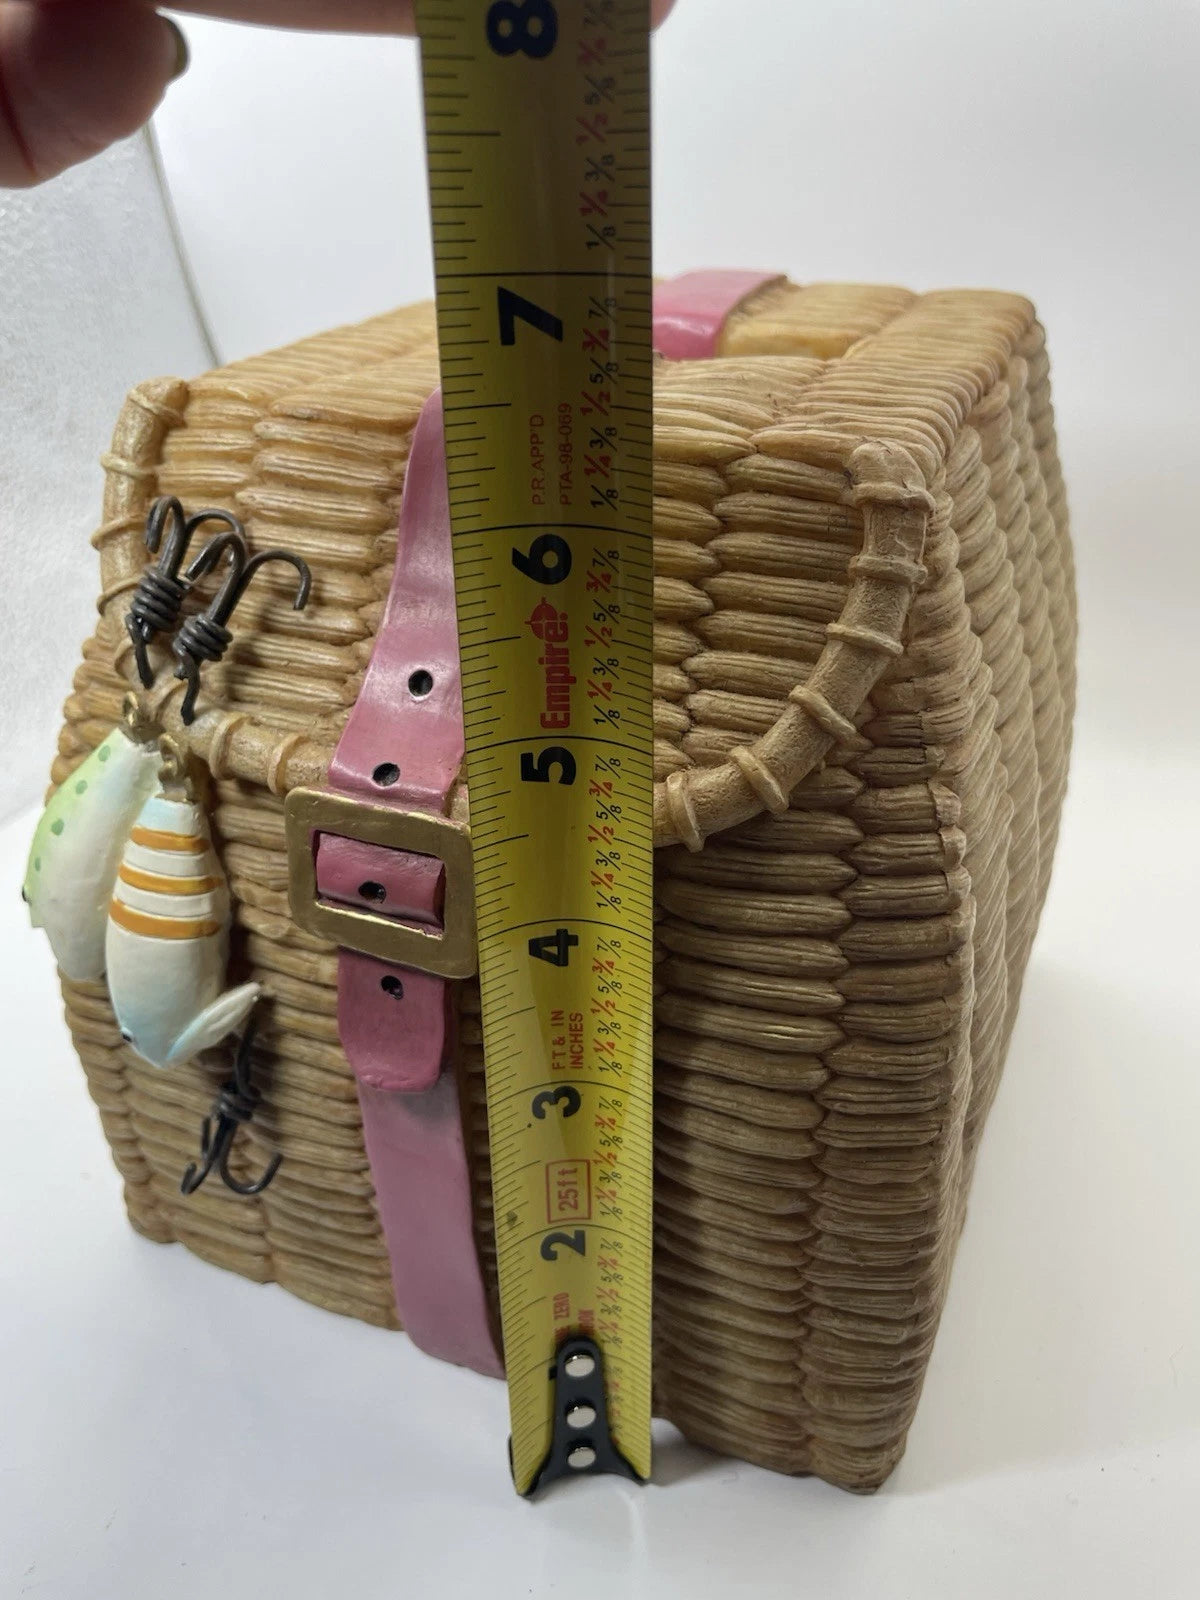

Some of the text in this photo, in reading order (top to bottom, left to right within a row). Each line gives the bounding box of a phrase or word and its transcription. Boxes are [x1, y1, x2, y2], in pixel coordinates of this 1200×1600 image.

[485, 0, 558, 58] 8
[497, 285, 563, 345] 7
[589, 357, 619, 384] 5/8
[589, 427, 617, 451] 3/8
[590, 485, 619, 511] 1/8
[512, 534, 572, 585] 6
[592, 548, 620, 573] 7/8
[593, 599, 621, 624] 5/8
[584, 625, 612, 648] 1/2
[592, 658, 620, 679] 3/8
[593, 705, 621, 729] 1/8
[521, 746, 576, 785] 5
[595, 755, 621, 779] 7/8
[596, 800, 622, 823] 5/8
[587, 824, 615, 845] 1/2
[595, 850, 621, 871] 3/8
[596, 890, 622, 913] 1/8
[528, 929, 578, 967] 4
[597, 936, 622, 958] 7/8
[598, 975, 622, 997] 5/8
[590, 998, 616, 1017] 1/2
[569, 1012, 583, 1069] INCHES
[598, 1020, 621, 1039] 3/8
[598, 1057, 622, 1078] 1/8
[532, 1086, 581, 1119] 3
[599, 1096, 622, 1116] 7/8
[600, 1130, 623, 1150] 5/8
[593, 1150, 618, 1168] 1/2
[599, 1169, 622, 1188] 3/8
[600, 1202, 623, 1221] 1/8
[540, 1230, 585, 1261] 2
